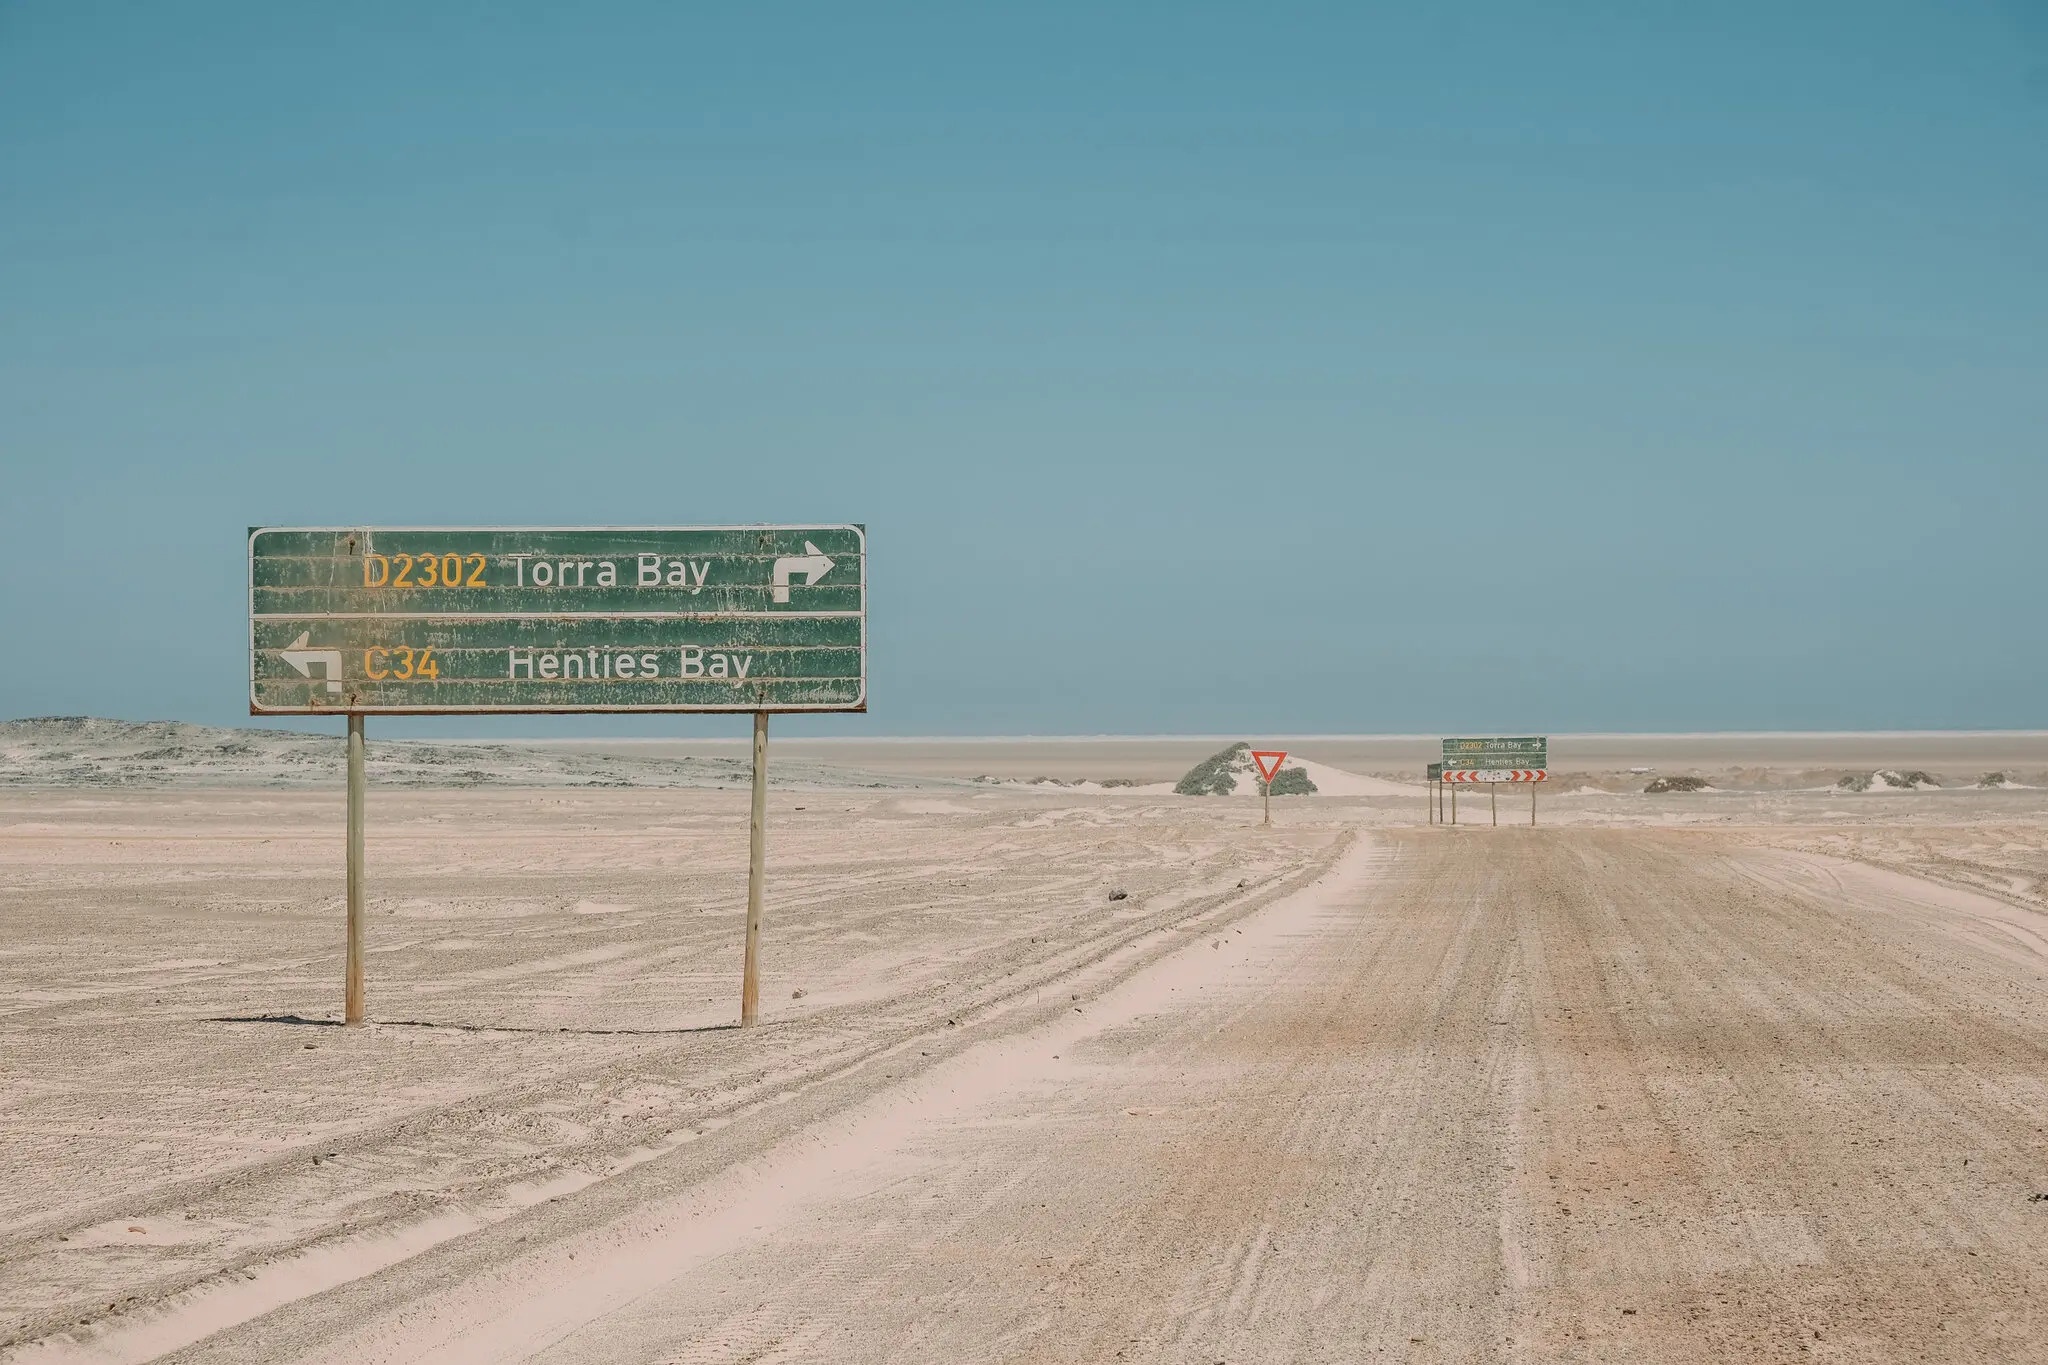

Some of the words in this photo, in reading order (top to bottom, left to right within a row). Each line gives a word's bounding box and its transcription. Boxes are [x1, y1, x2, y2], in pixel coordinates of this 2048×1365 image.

[363, 553, 487, 588] D2302
[508, 554, 616, 587] Torra
[637, 554, 711, 595] Bay
[364, 646, 439, 681] C34
[508, 645, 658, 679] Henties
[680, 645, 753, 688] Bay
[1508, 742, 1522, 750] Bay
[1515, 758, 1530, 766] Bay
